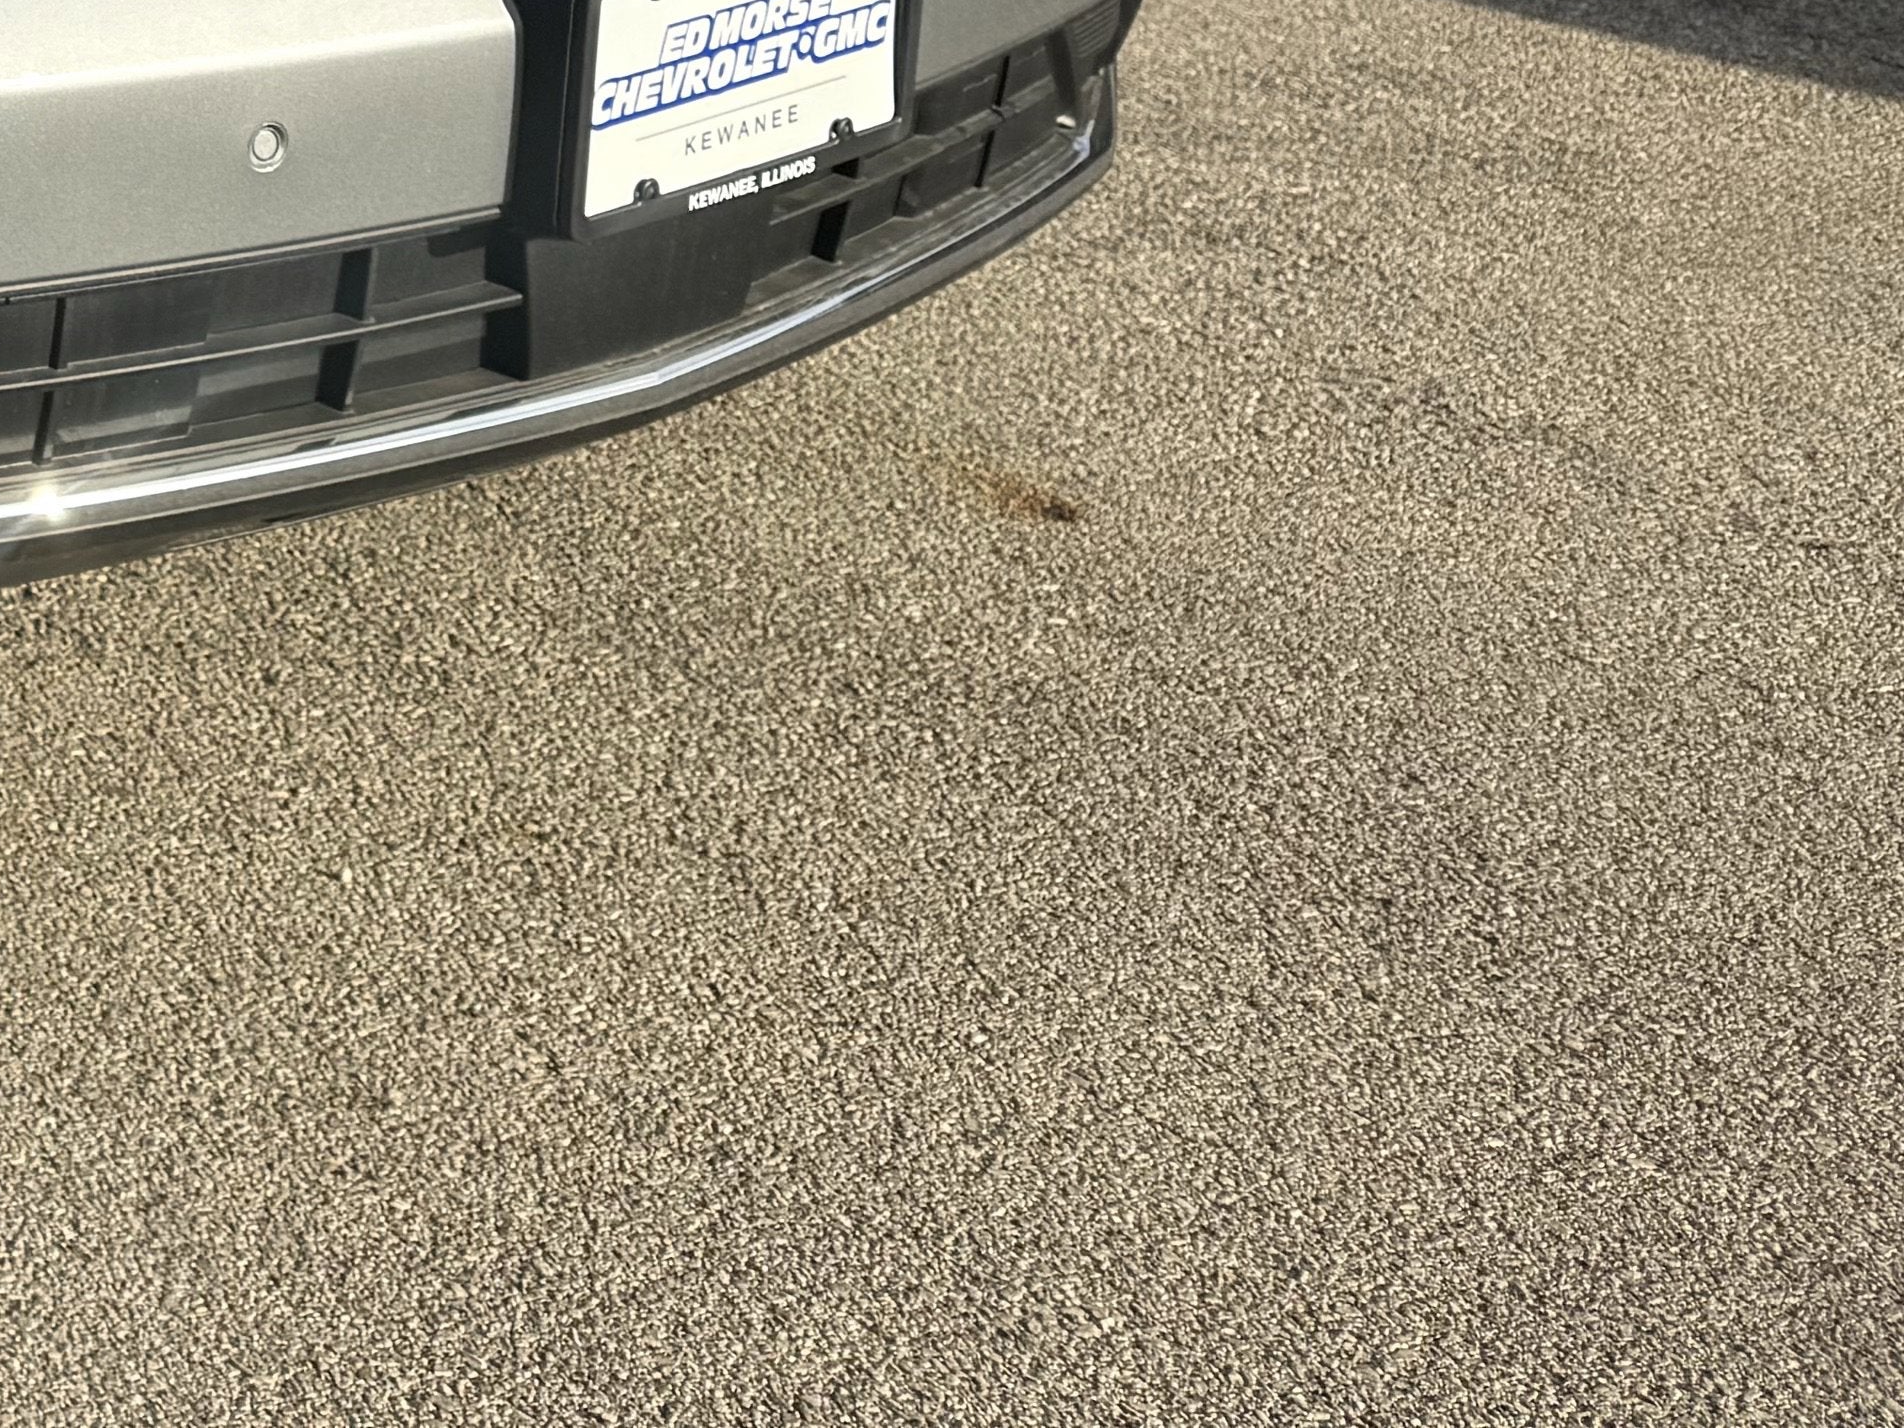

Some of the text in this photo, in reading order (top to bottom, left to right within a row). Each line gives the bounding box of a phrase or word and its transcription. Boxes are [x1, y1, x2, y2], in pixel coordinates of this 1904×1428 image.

[684, 103, 799, 157] KEWANEE
[688, 156, 816, 212] KEWANEE, ILLINOIS
